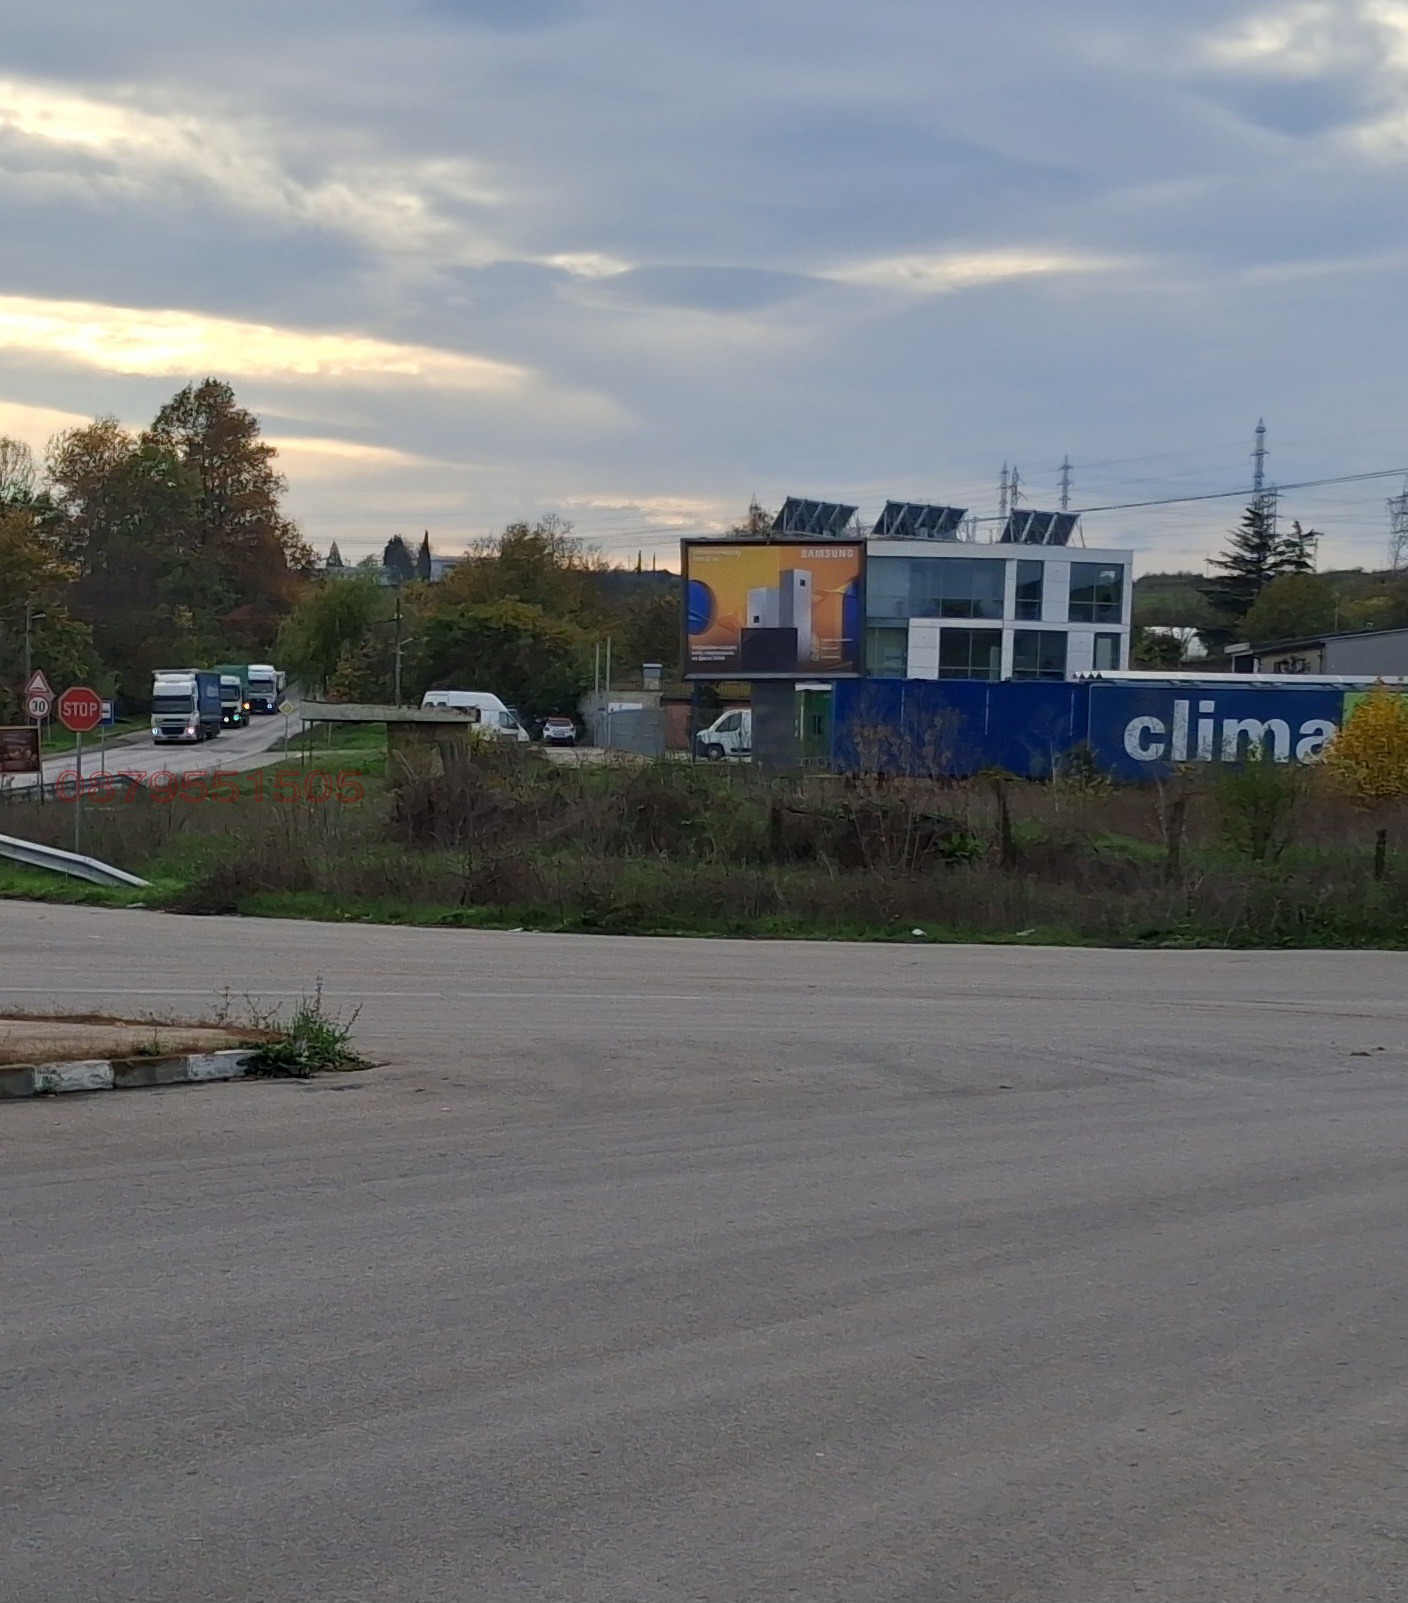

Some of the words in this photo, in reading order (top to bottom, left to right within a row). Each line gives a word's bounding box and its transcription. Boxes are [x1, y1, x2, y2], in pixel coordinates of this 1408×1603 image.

[801, 548, 854, 559] SAMSUNG
[32, 700, 46, 712] 30
[63, 701, 98, 717] STOP
[1123, 699, 1337, 765] clima
